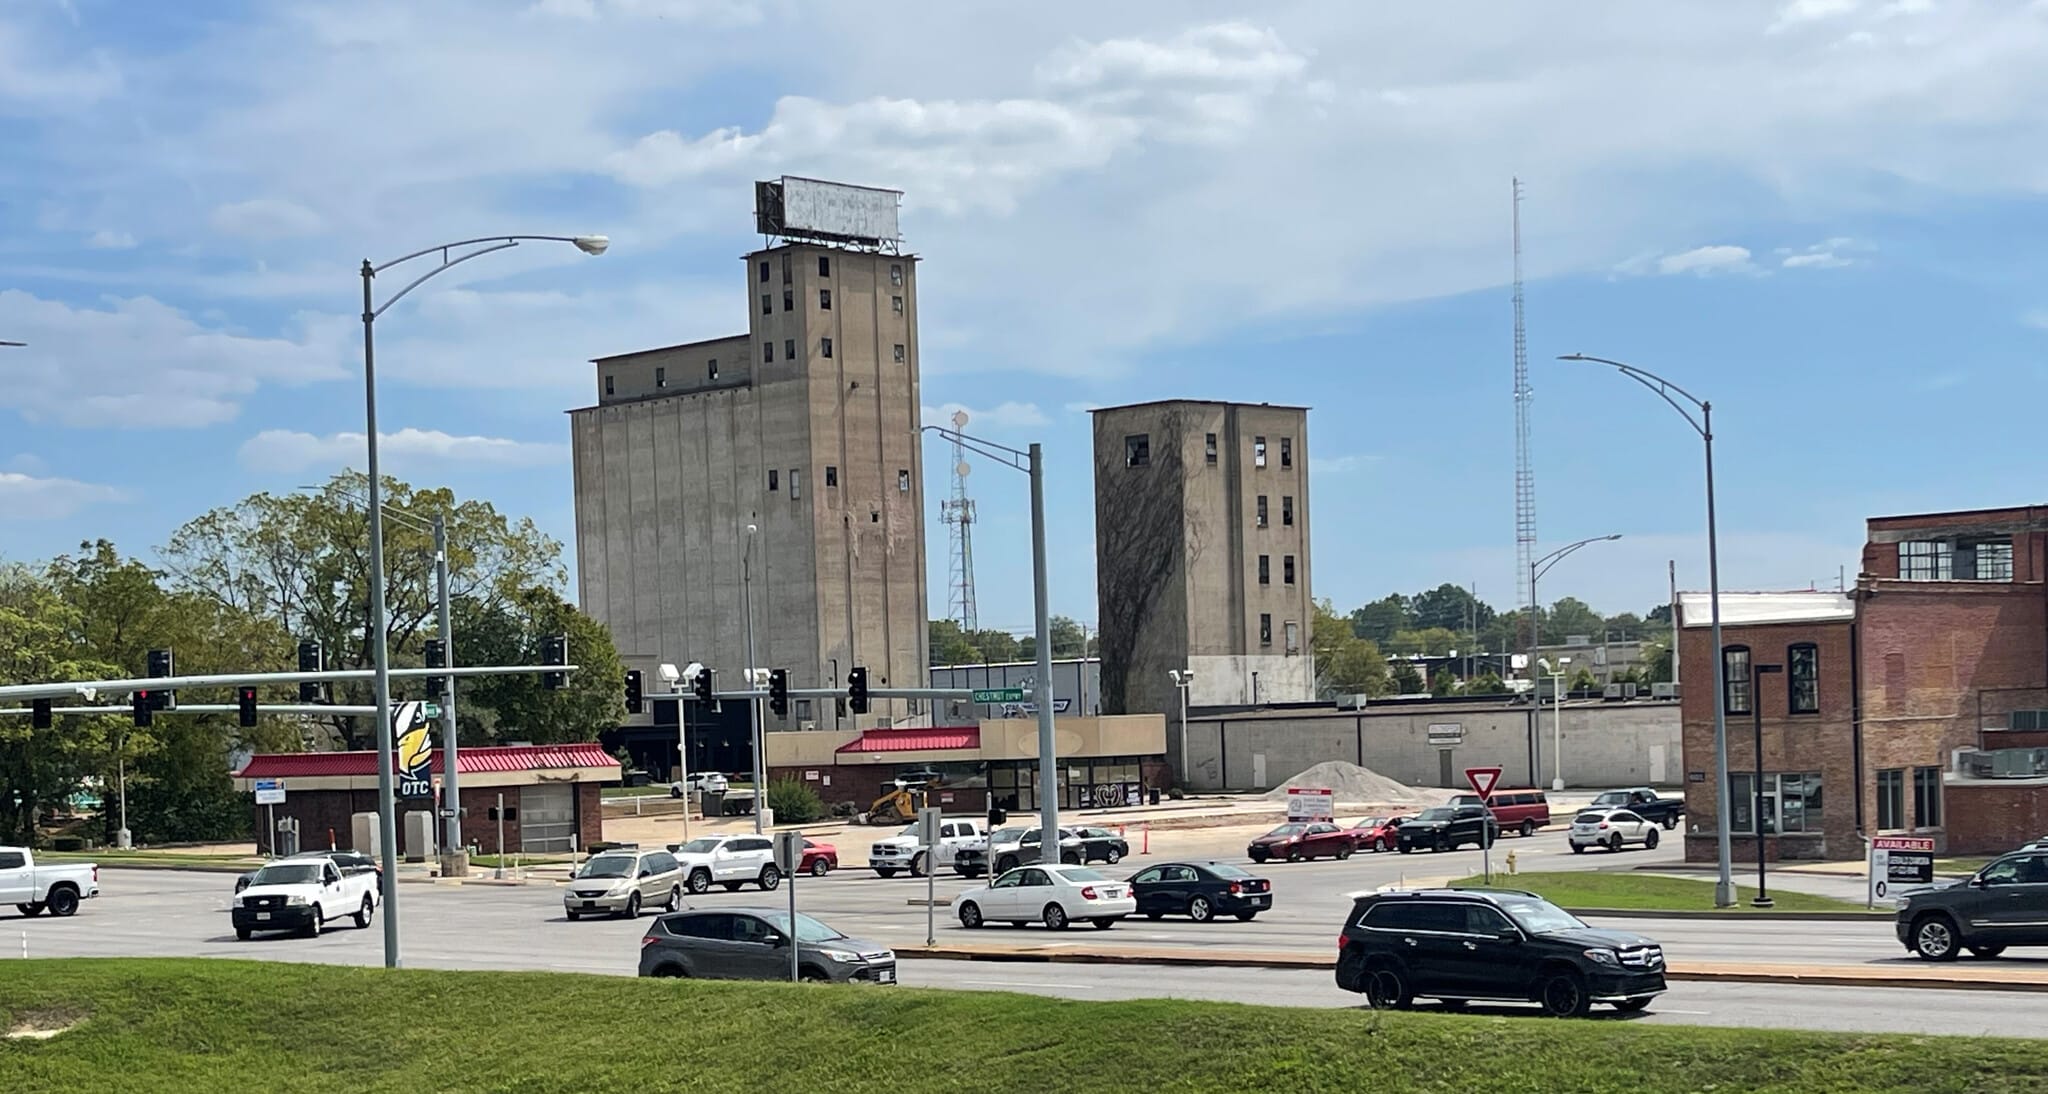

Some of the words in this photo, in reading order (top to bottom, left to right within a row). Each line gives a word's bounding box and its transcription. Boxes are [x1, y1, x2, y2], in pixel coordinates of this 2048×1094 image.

[975, 691, 1005, 701] CHESTNUT
[402, 781, 429, 795] OTC
[1876, 840, 1930, 849] AVAILABLE
